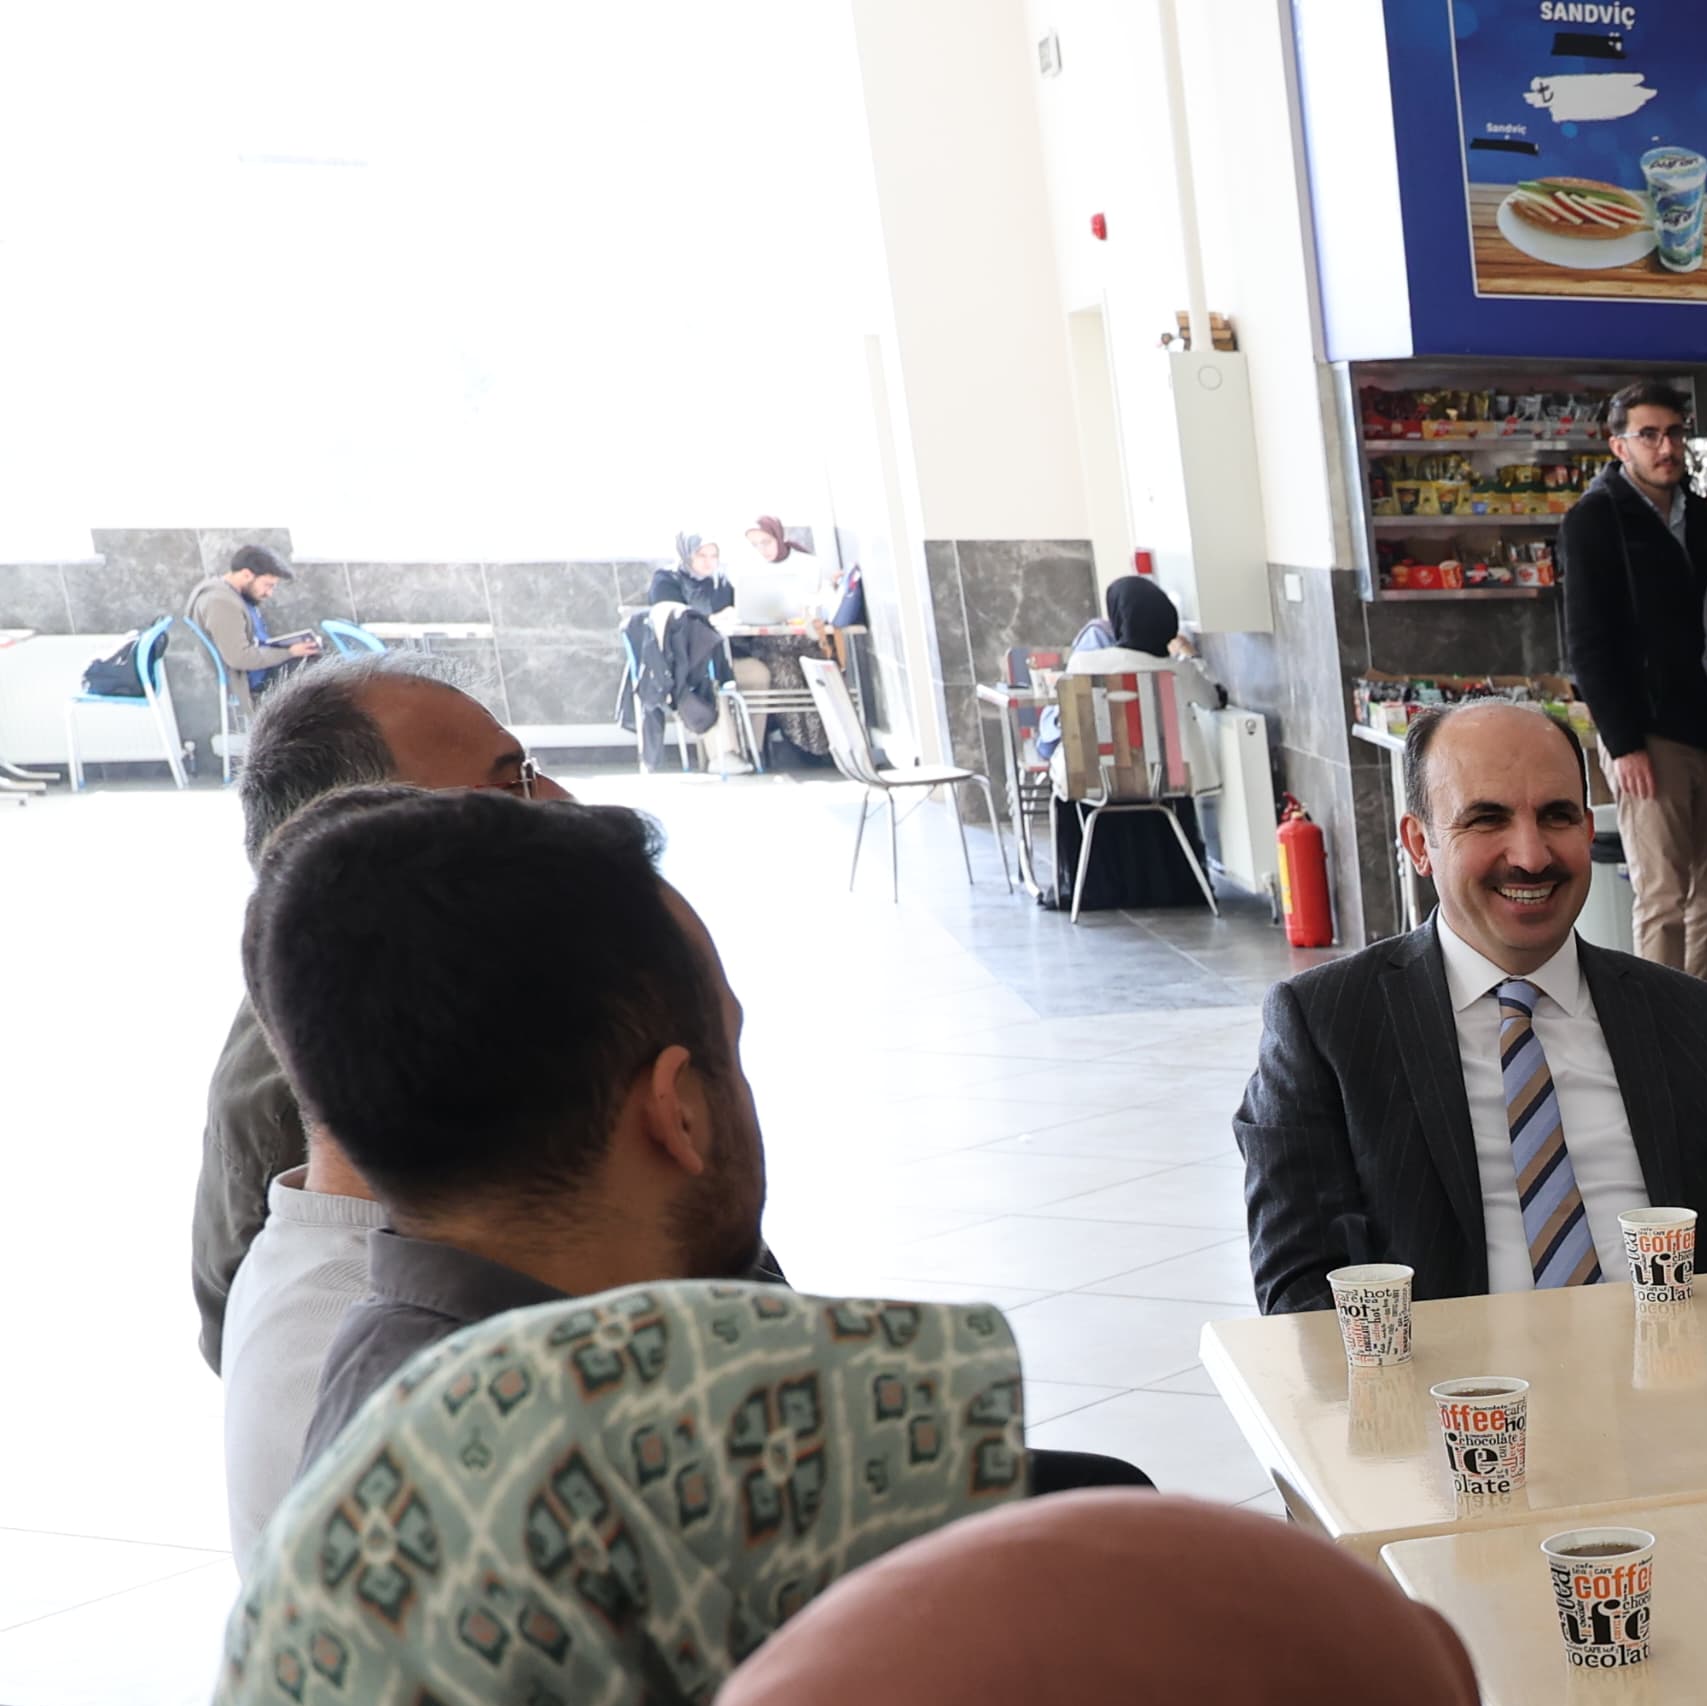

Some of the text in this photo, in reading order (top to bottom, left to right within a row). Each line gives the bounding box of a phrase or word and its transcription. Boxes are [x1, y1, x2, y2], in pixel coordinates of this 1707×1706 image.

[1540, 1, 1636, 30] SANDVİÇ
[1486, 122, 1527, 135] Sandviç
[1363, 1288, 1392, 1298] hot
[1441, 1404, 1505, 1432] offee
[1459, 1432, 1518, 1447] chocolate
